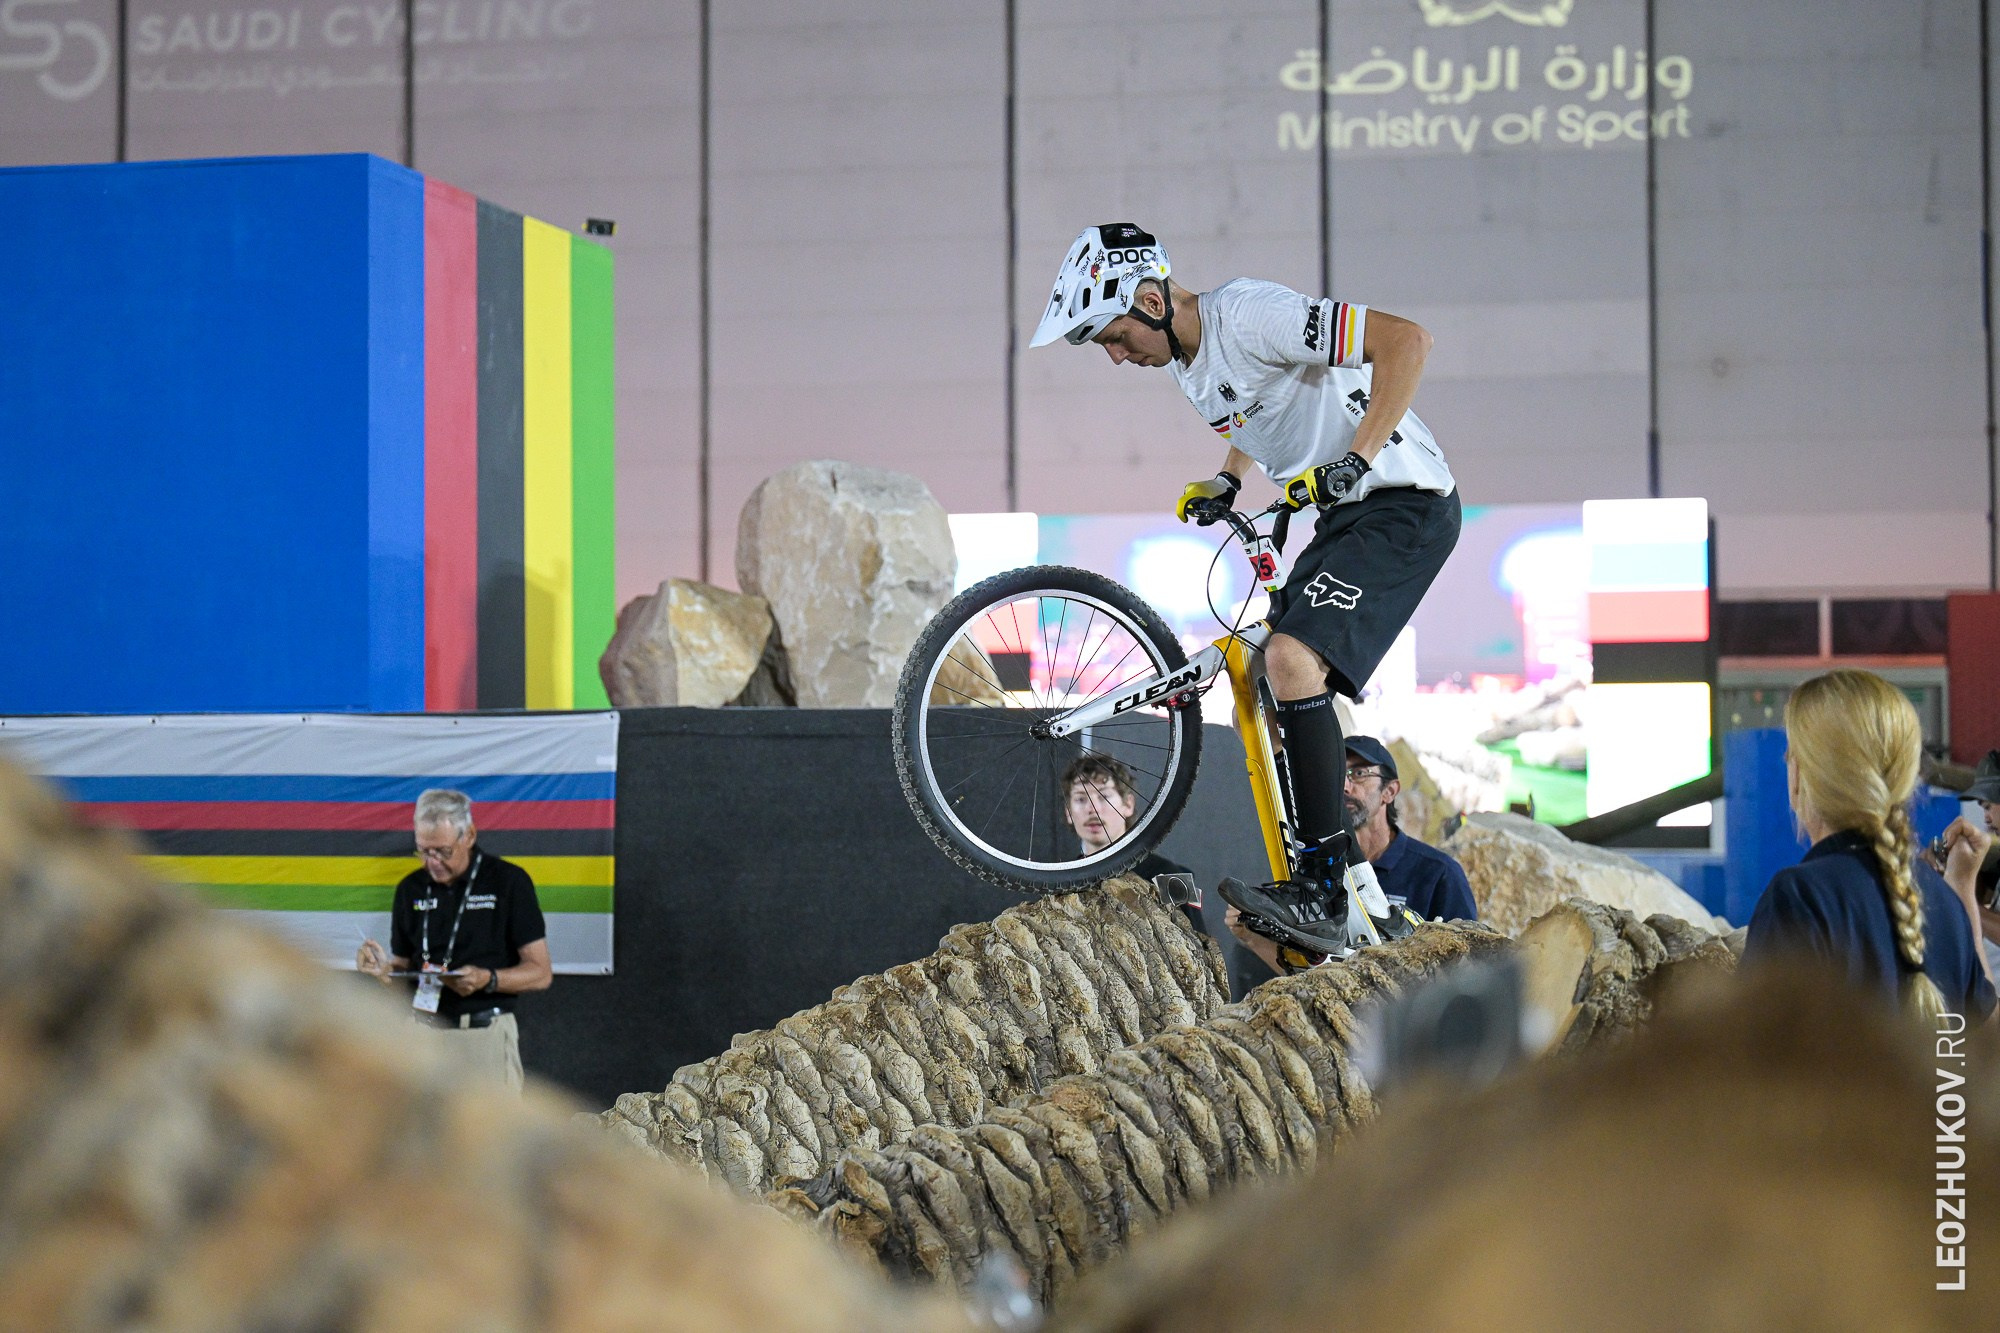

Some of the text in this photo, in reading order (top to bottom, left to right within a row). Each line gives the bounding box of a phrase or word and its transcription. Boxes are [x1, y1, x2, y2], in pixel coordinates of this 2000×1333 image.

[134, 0, 594, 54] SAUDI CYCLING
[1279, 44, 1693, 104] وزارة الرياضة
[1277, 103, 1691, 153] Ministry of Sport
[1303, 304, 1320, 352] KTM
[1345, 402, 1361, 417] BIKE
[1113, 664, 1202, 715] CLEAN
[1294, 699, 1326, 711] hebo
